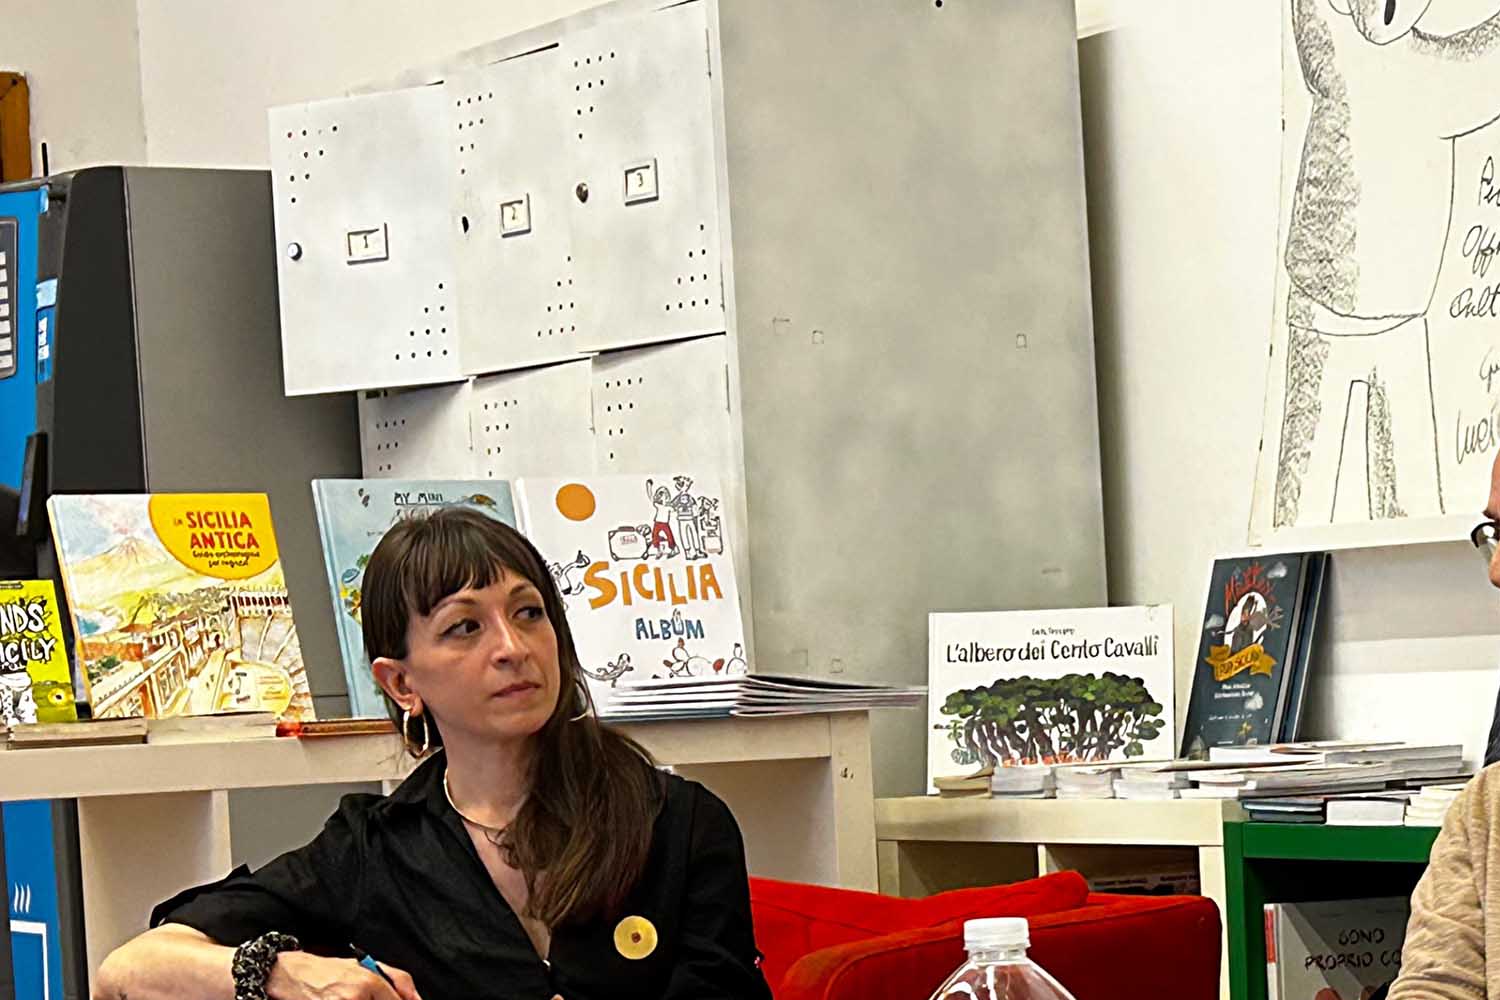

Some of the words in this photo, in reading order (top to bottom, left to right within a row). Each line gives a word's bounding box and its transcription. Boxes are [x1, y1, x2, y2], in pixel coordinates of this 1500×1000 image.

[185, 511, 253, 529] SICILIA
[190, 532, 259, 550] ANTICA
[583, 560, 723, 610] SICILIA
[0, 603, 45, 636] NDS
[635, 614, 705, 641] ALBUM
[0, 638, 56, 664] ICILY
[946, 642, 1017, 663] L'albero
[1018, 640, 1045, 660] dei
[1051, 639, 1102, 660] Cento
[1104, 634, 1160, 658] Cavalli
[1304, 951, 1374, 971] PROPRIO
[1380, 949, 1402, 967] CO
